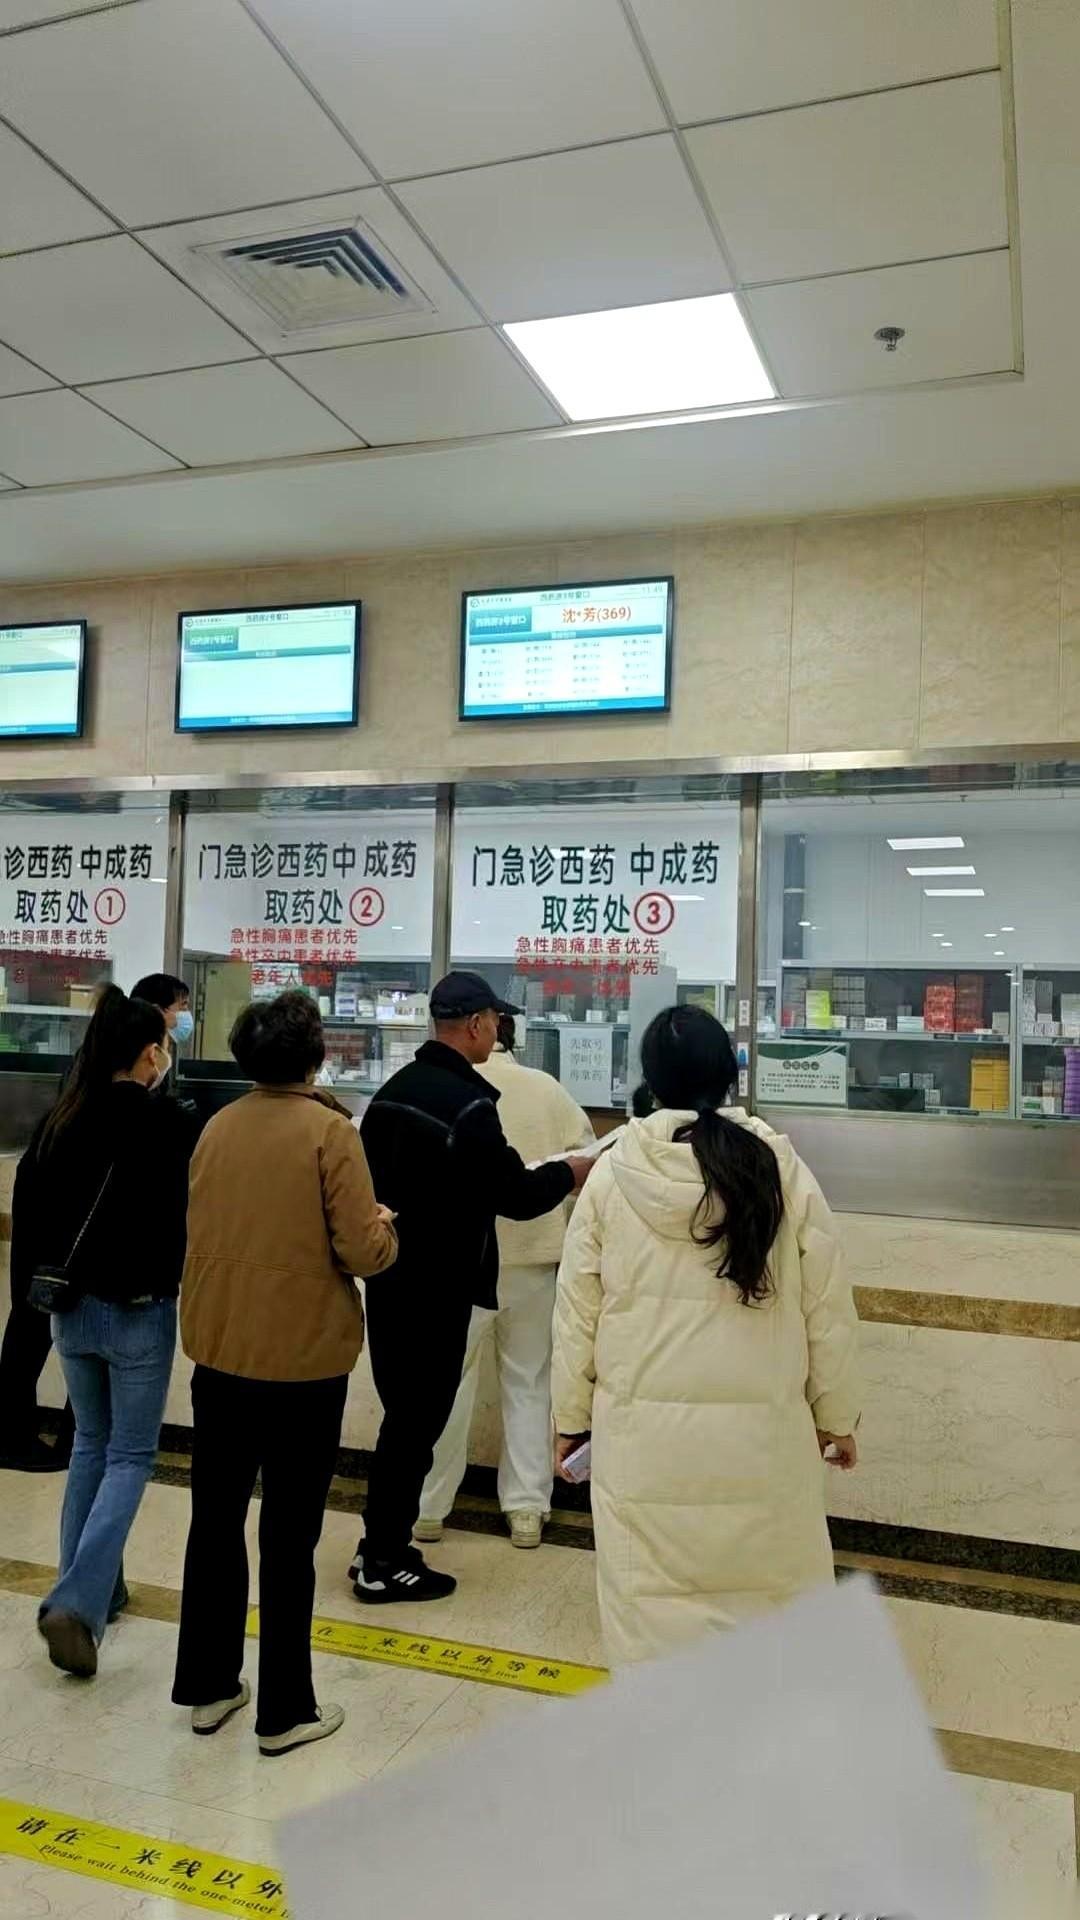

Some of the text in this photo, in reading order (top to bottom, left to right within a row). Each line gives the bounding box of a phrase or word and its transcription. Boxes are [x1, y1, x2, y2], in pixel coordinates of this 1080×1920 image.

[231, 928, 358, 944] 急性胸痛患者优先
[515, 936, 660, 954] 急性胸痛患者优先
[16, 1817, 283, 1899] 请在一米线以外
[40, 1844, 83, 1861] Please
[87, 1858, 117, 1871] wait
[120, 1865, 169, 1885] behind
[172, 1880, 196, 1893] the
